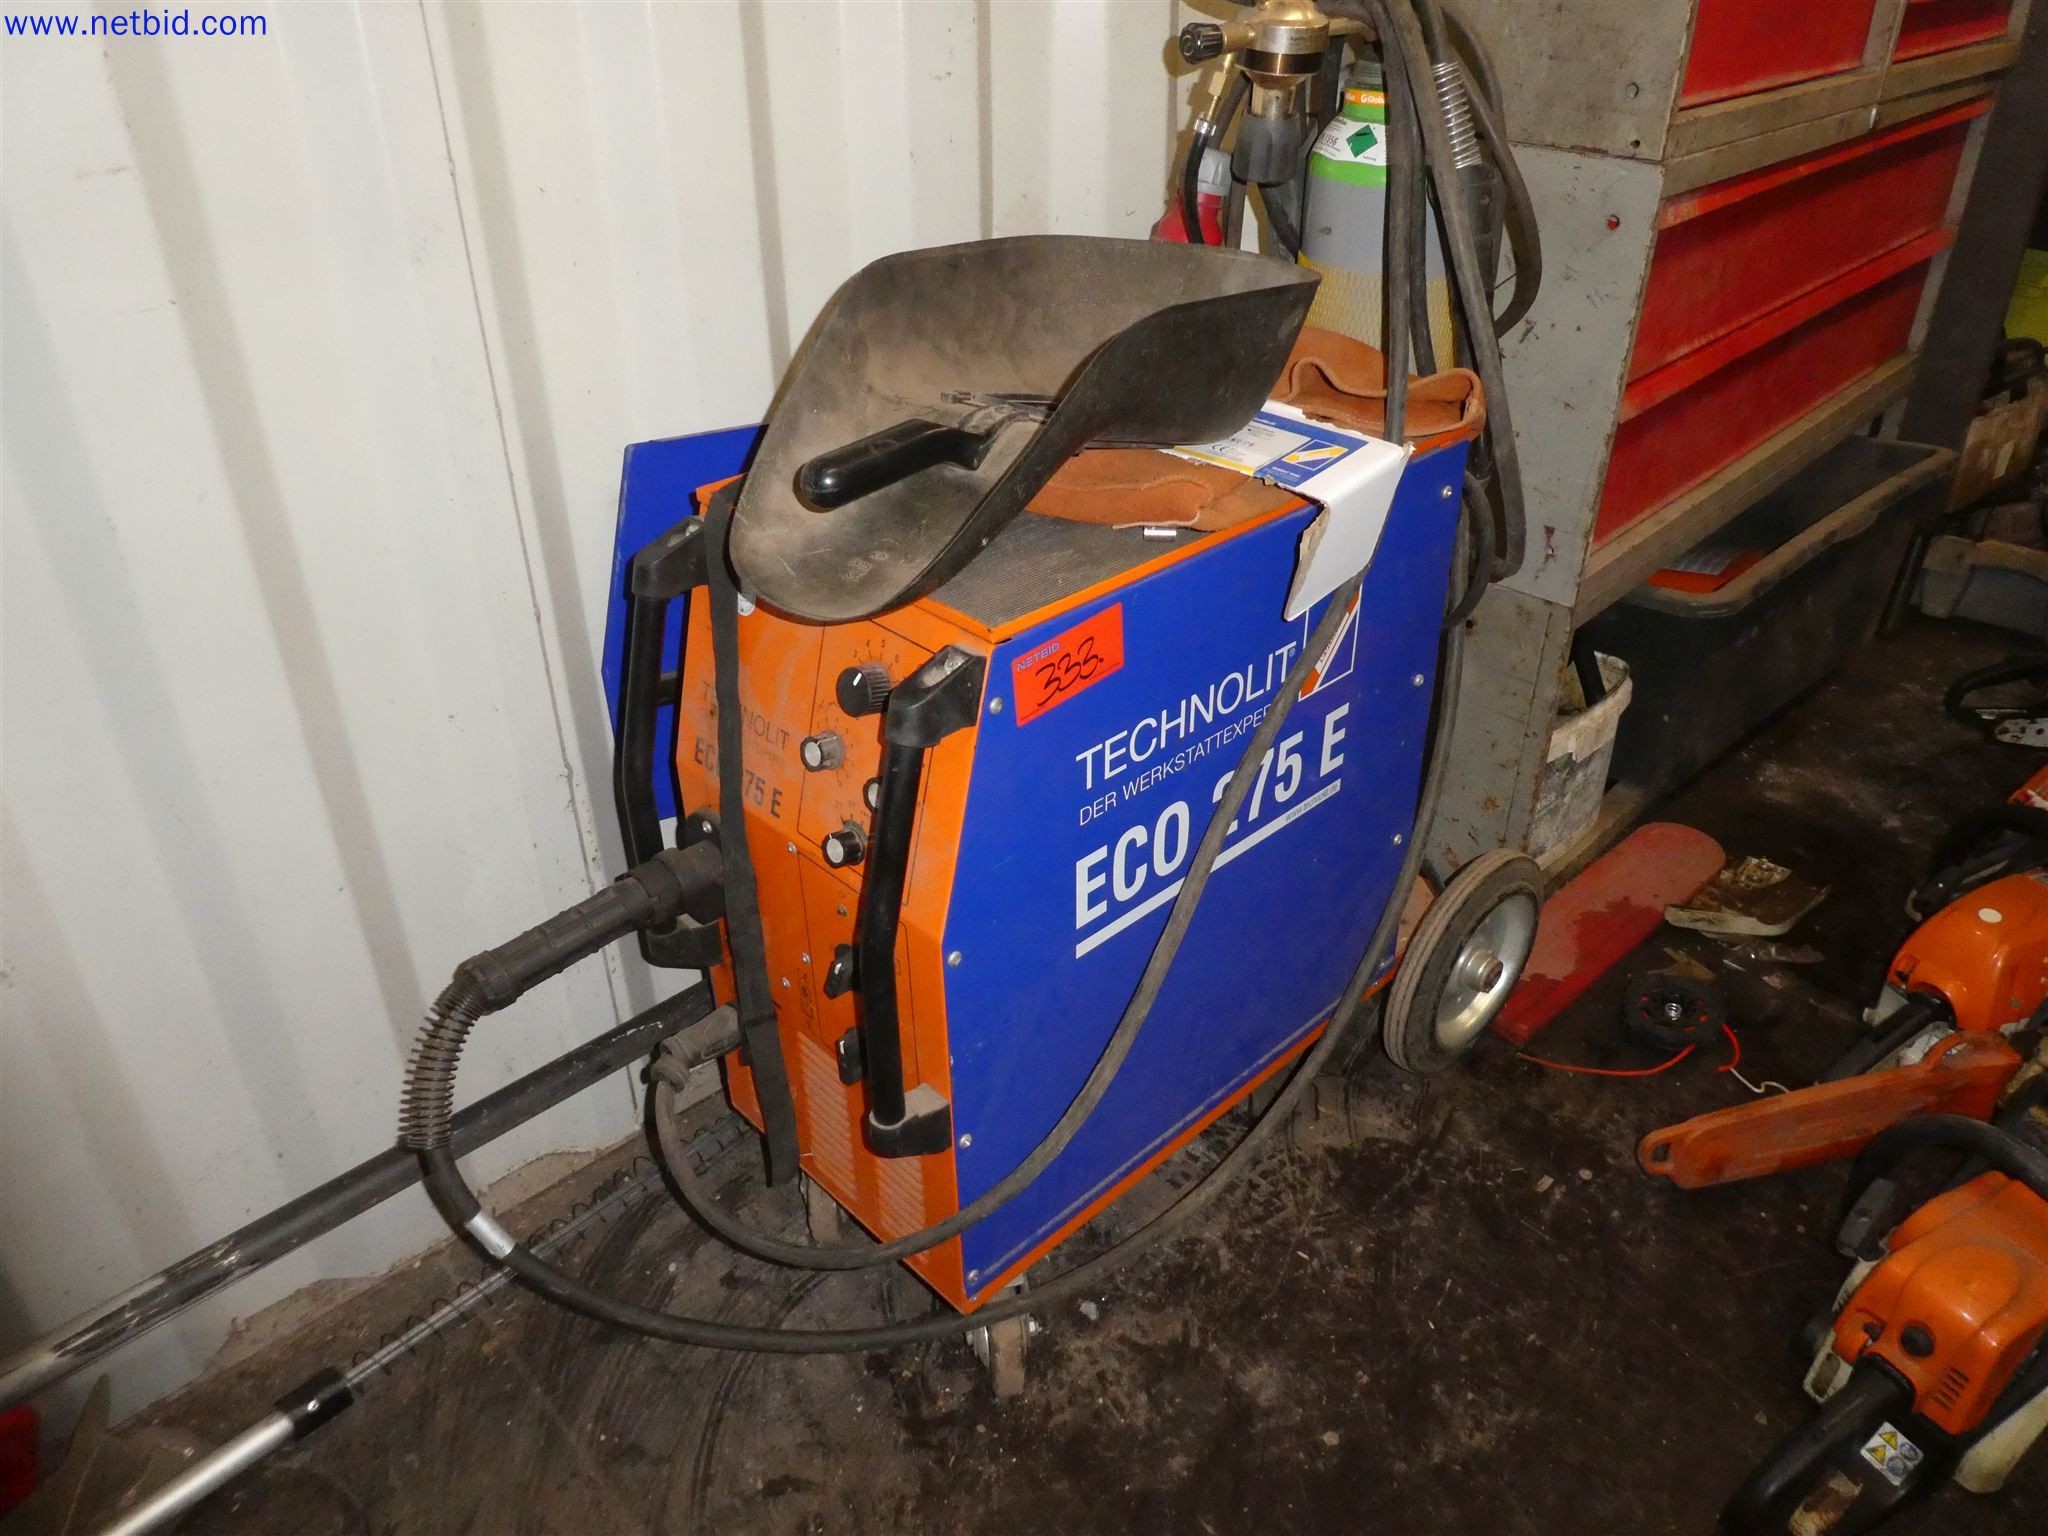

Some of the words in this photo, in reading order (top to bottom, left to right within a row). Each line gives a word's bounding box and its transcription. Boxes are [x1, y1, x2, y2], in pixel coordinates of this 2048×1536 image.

[1017, 642, 1061, 671] NETBID
[1075, 800, 1190, 930] ECO
[1319, 702, 1350, 778] E
[1080, 791, 1117, 826] DER
